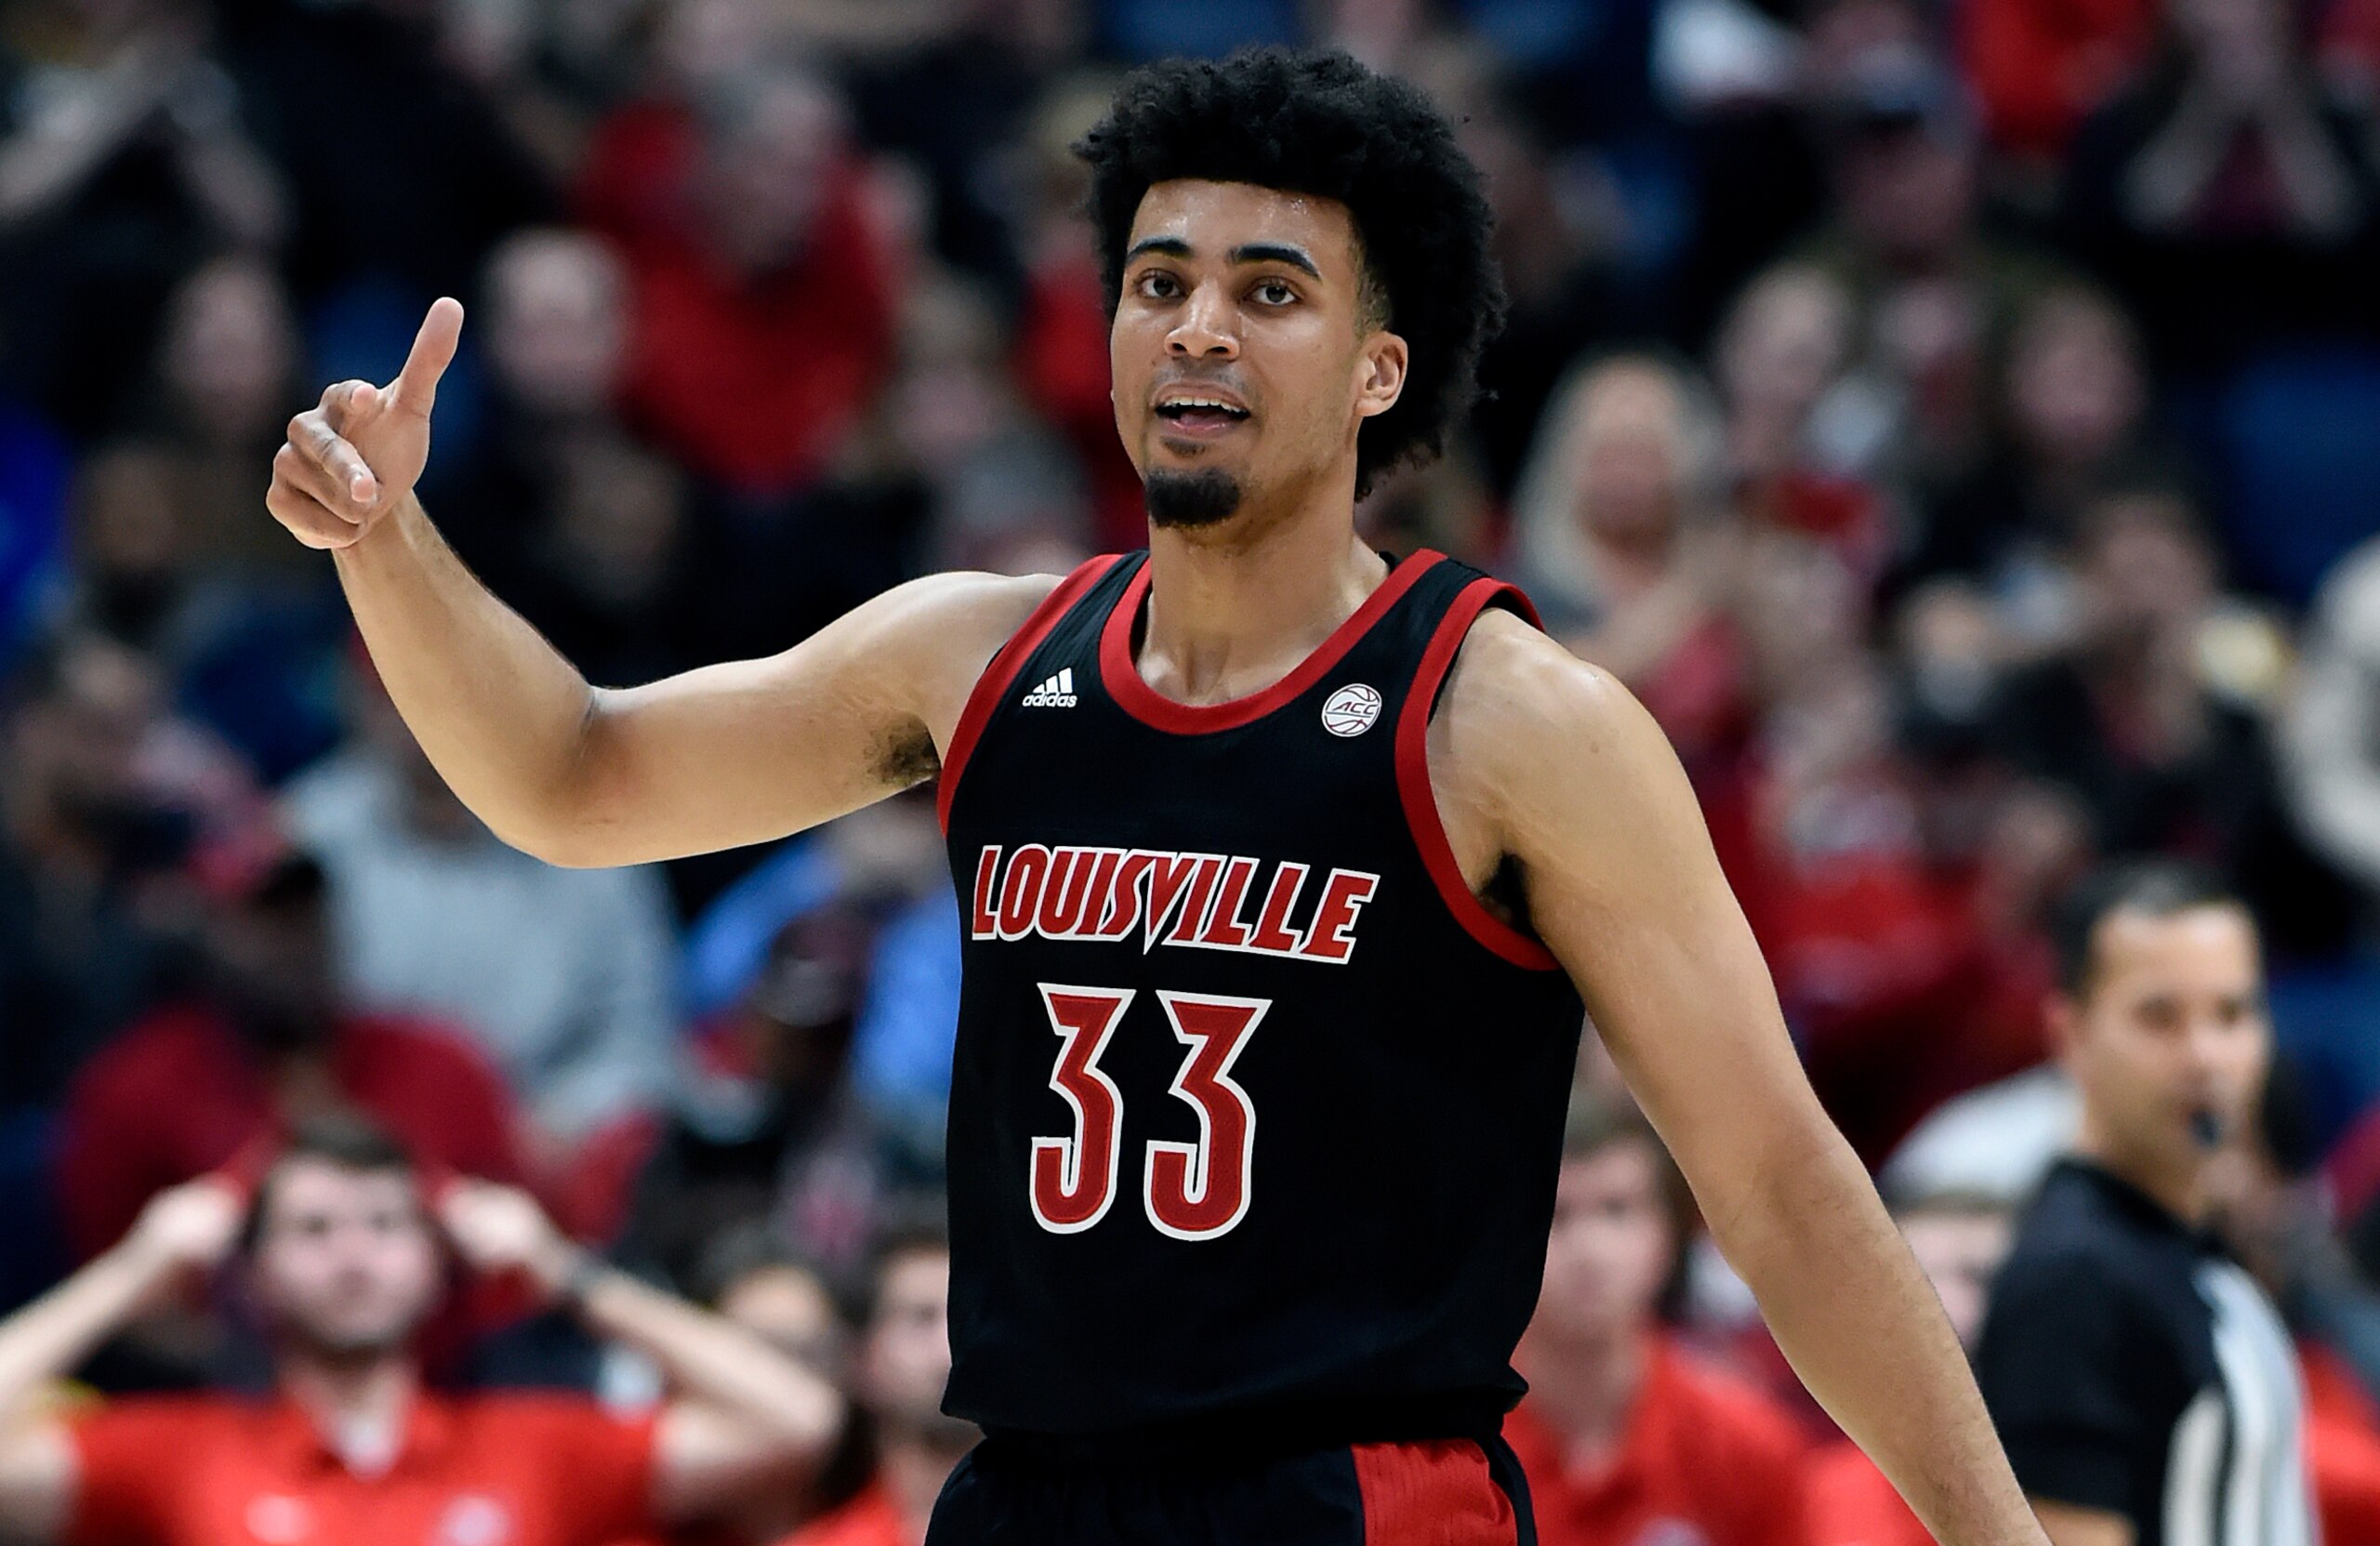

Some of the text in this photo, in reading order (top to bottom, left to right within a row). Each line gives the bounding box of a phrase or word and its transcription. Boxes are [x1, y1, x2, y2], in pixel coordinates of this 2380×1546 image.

[1022, 692, 1078, 707] adidas
[1332, 701, 1378, 715] ACC
[972, 843, 1381, 965] LOUISVILLE
[1029, 983, 1273, 1242] 33
